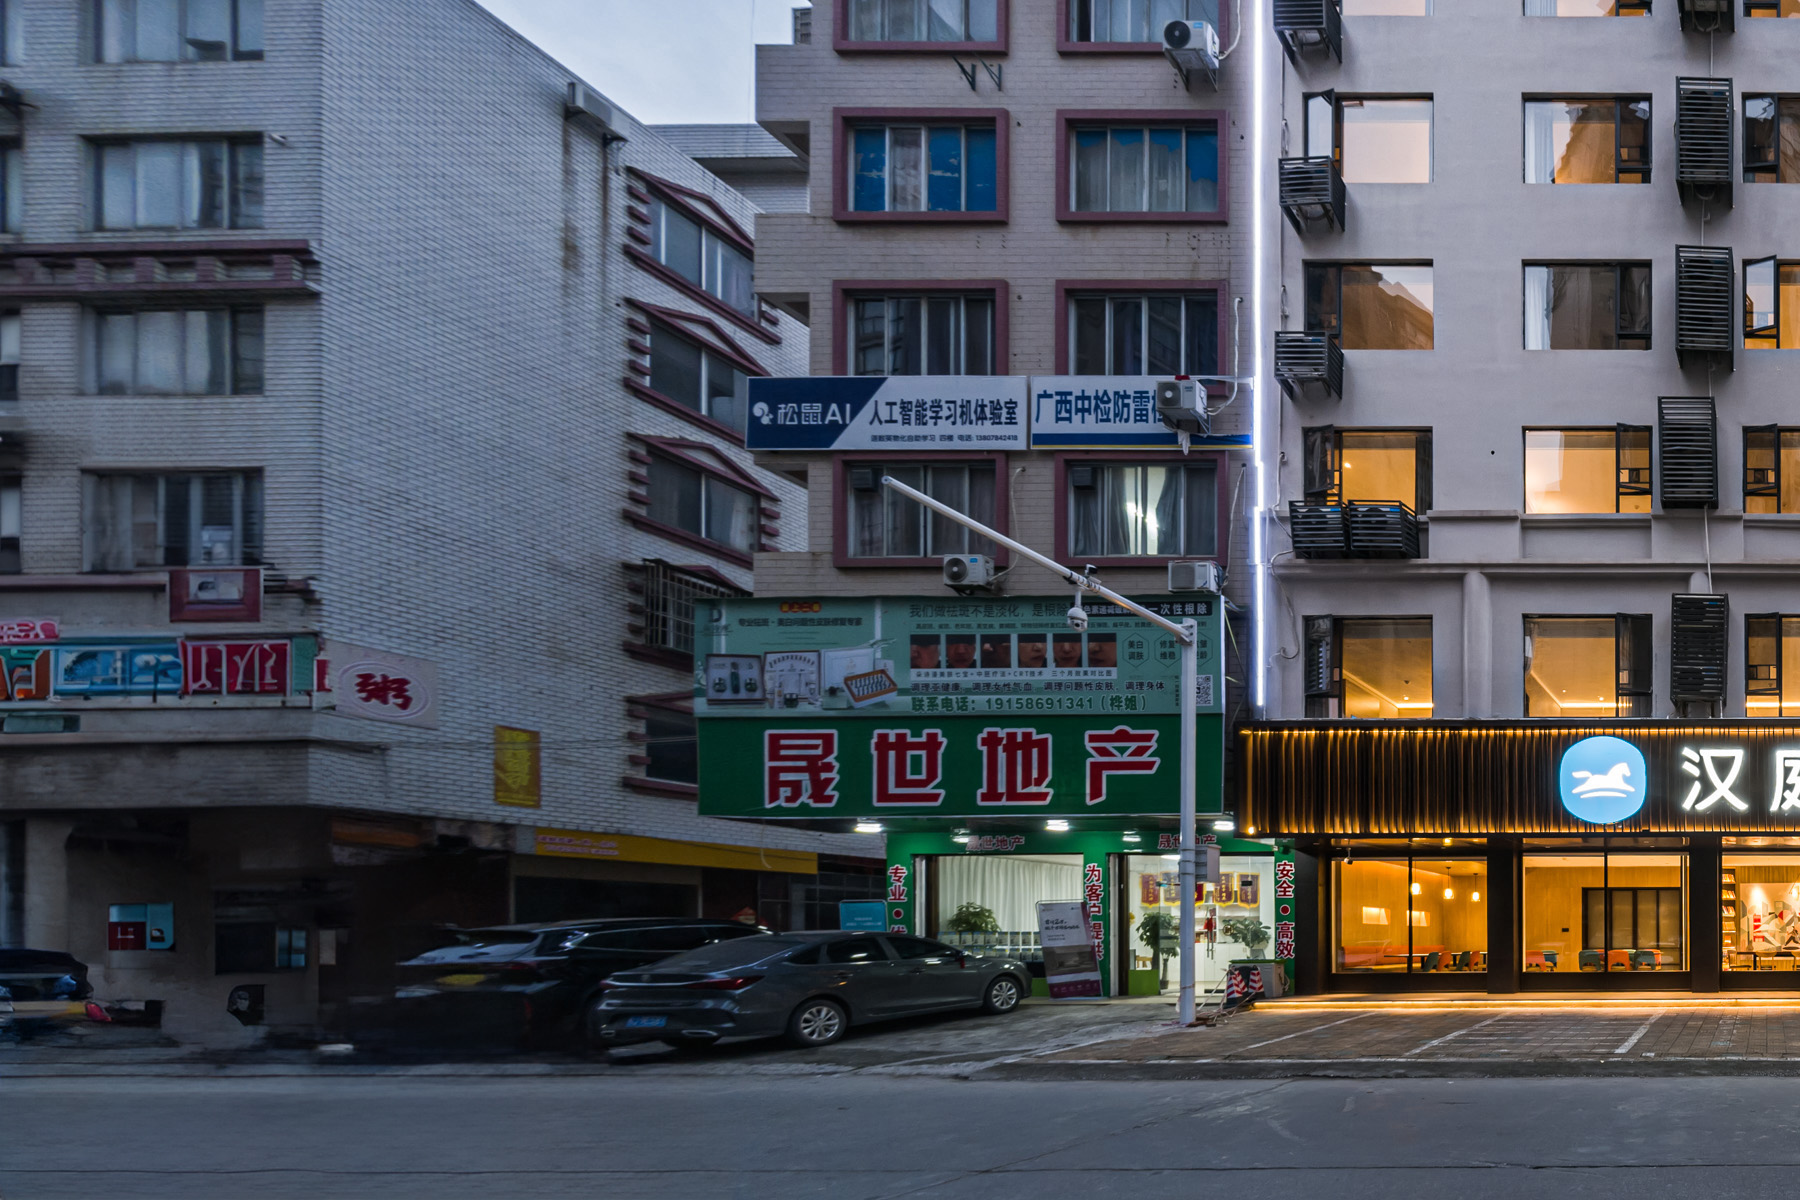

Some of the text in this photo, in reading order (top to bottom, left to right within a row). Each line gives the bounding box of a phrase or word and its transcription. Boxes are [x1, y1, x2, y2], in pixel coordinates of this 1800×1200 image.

[777, 402, 850, 425] 松鼠AI
[869, 398, 1018, 426] 人工智能学习机体验室
[354, 672, 413, 711] 粥
[763, 726, 1161, 808] 晟世地产
[965, 834, 1026, 851] 晟世地产
[887, 864, 909, 902] 专业
[1275, 861, 1295, 898] 安全
[1275, 921, 1295, 959] 高效
